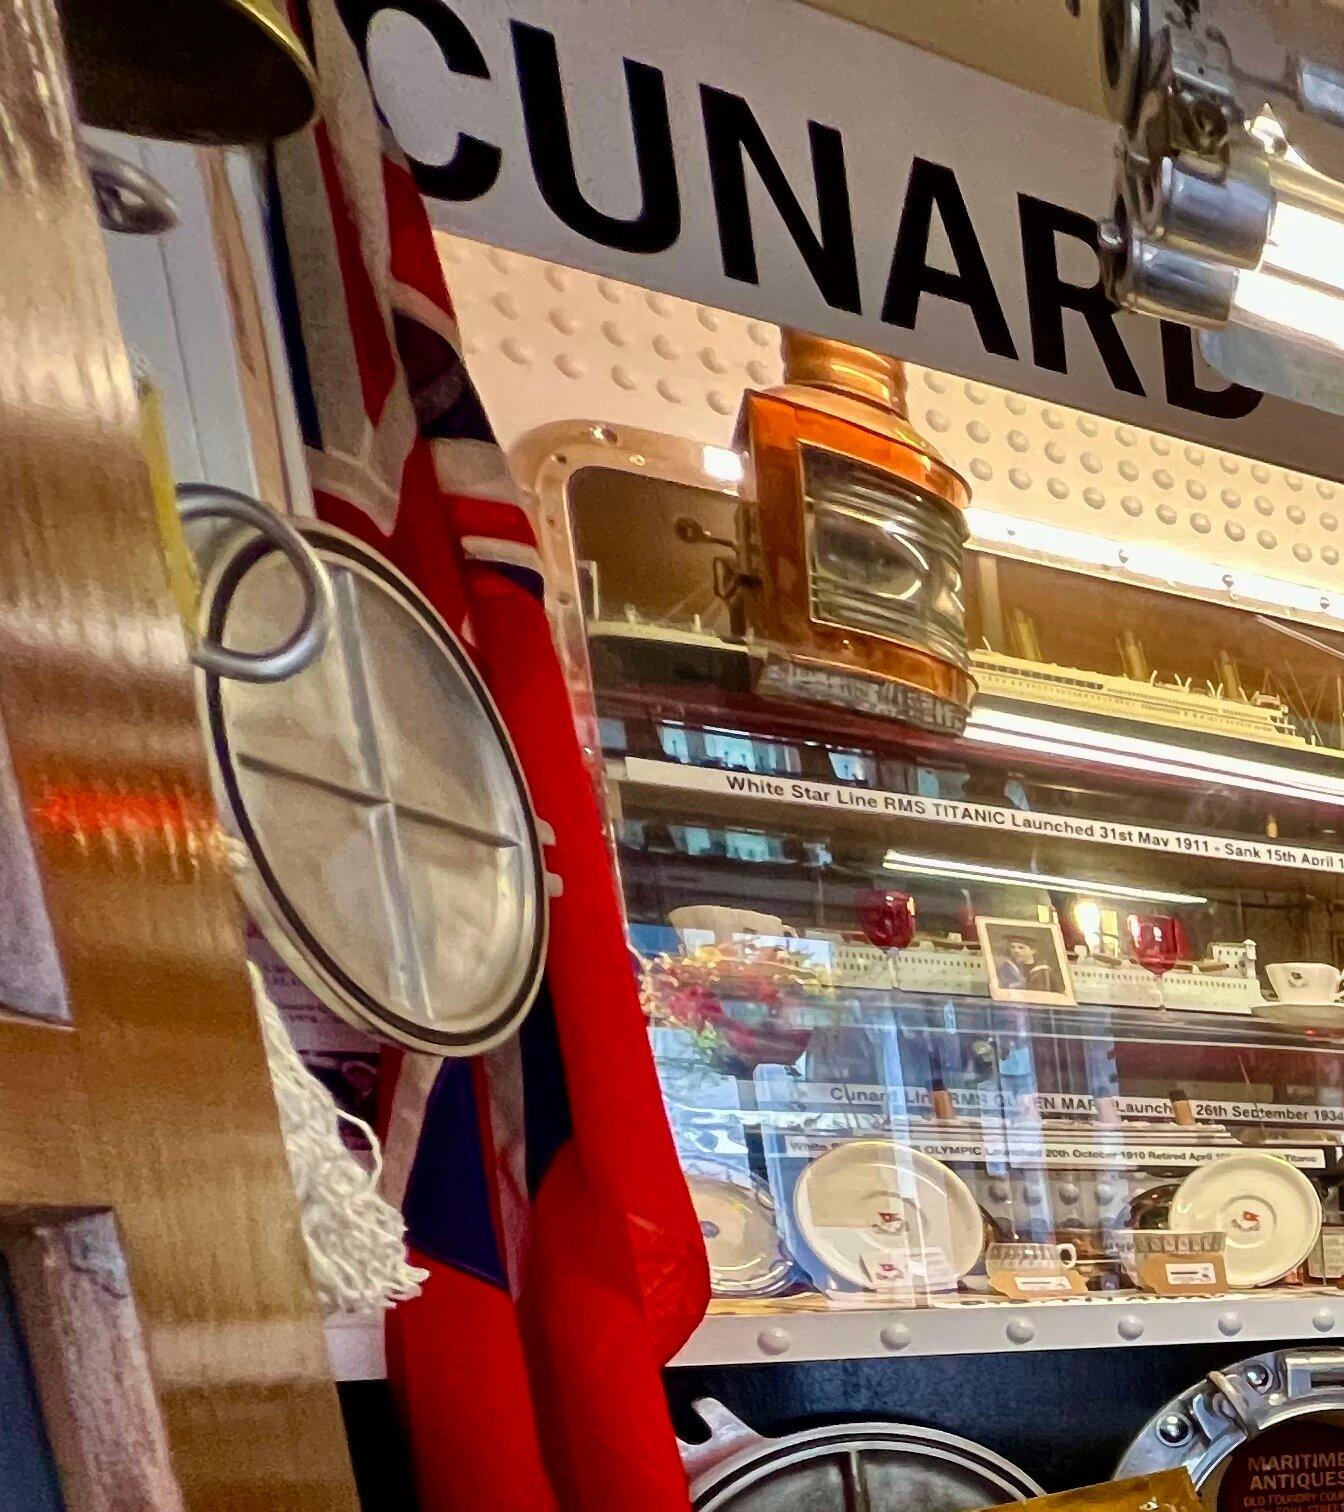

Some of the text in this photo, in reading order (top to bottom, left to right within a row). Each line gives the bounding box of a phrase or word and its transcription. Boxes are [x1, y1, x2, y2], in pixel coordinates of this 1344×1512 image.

[726, 774, 785, 797] White
[792, 785, 829, 802] Star
[838, 790, 878, 809] Line
[884, 796, 926, 815] RMS
[933, 802, 1005, 825] TITANIC
[1012, 813, 1095, 838] Launched
[1100, 826, 1133, 843] 31st
[1176, 836, 1210, 853] 1911
[1225, 843, 1261, 860] Sank
[1266, 849, 1297, 864] 15th
[1196, 1103, 1228, 1118] 26th
[1232, 1105, 1308, 1122] September
